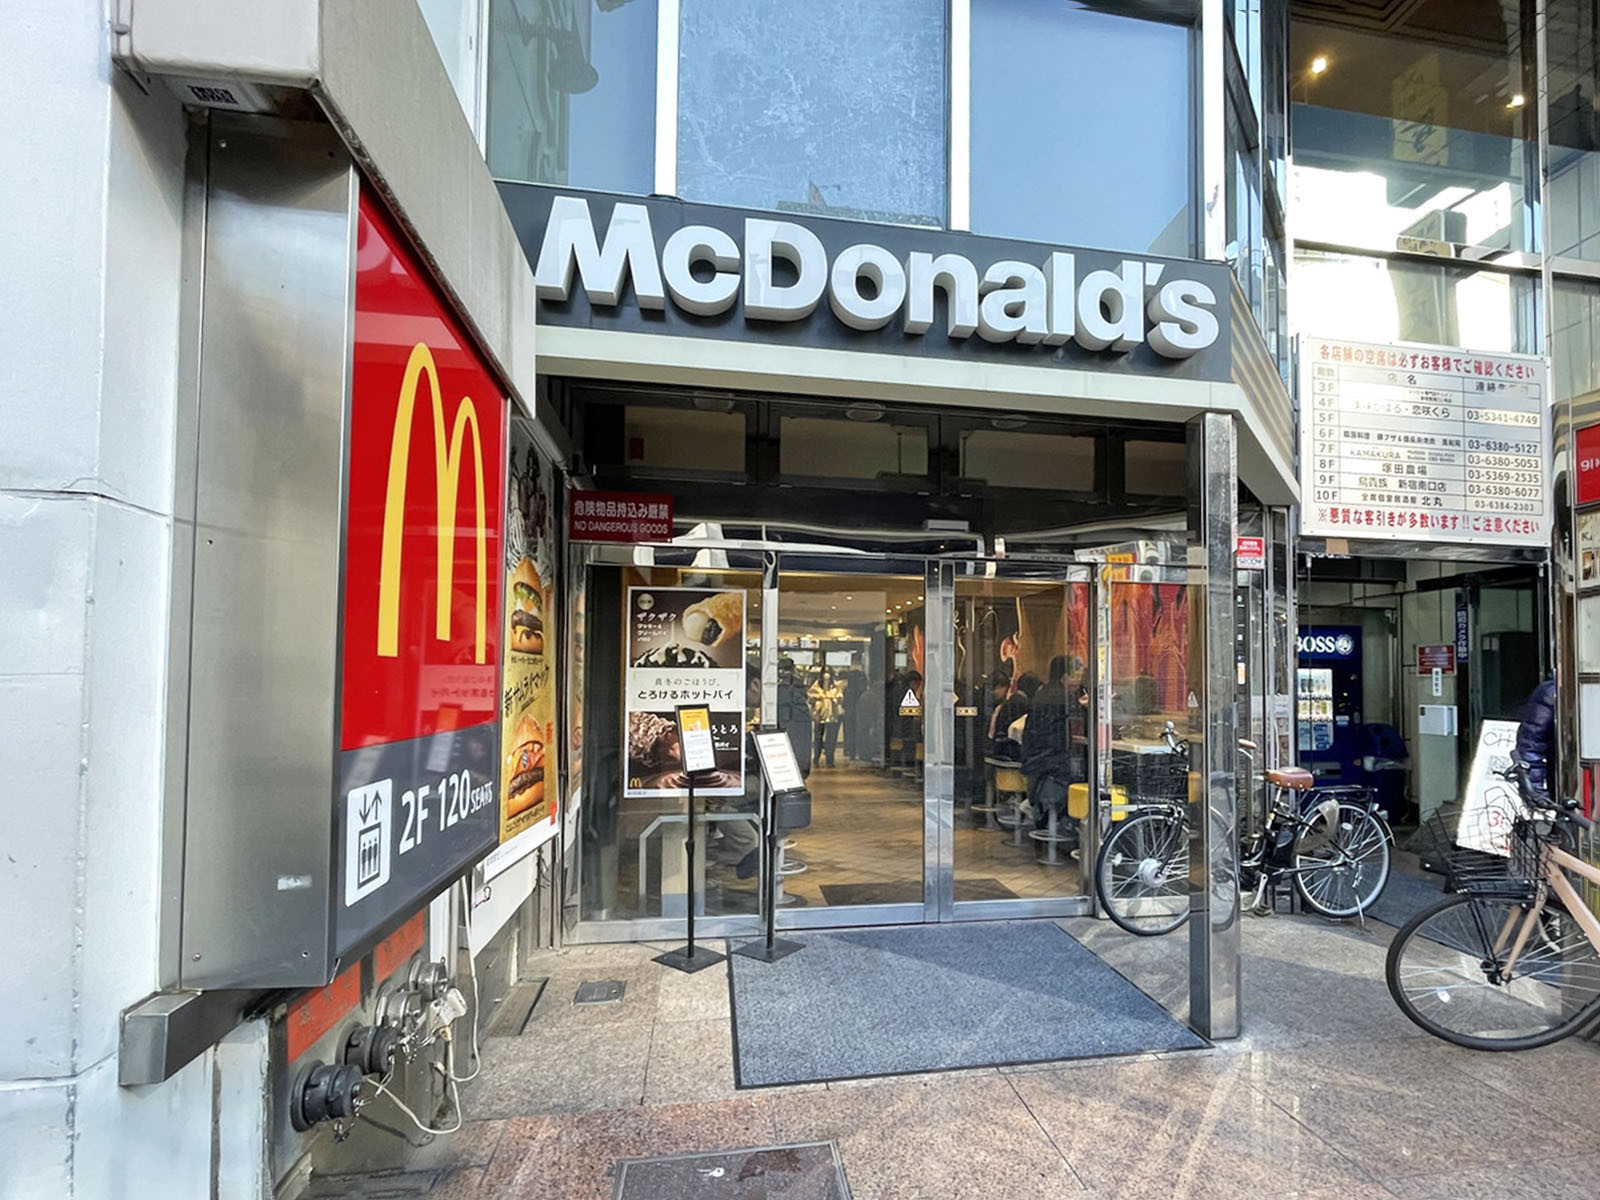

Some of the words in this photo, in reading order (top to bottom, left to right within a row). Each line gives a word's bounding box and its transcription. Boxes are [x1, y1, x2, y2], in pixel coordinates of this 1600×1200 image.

[535, 195, 1220, 359] McDonald's
[1468, 439, 1538, 454] 03-6380-5127
[1468, 455, 1539, 469] 03-6380-5053
[1468, 469, 1539, 483] 03-5369-2535
[1468, 484, 1540, 498] 03-6380-6077
[574, 520, 587, 531] NO
[588, 521, 638, 533] DANGEROUS
[399, 785, 430, 856] 2F
[438, 768, 471, 832] 120
[470, 781, 493, 814] SEATS
